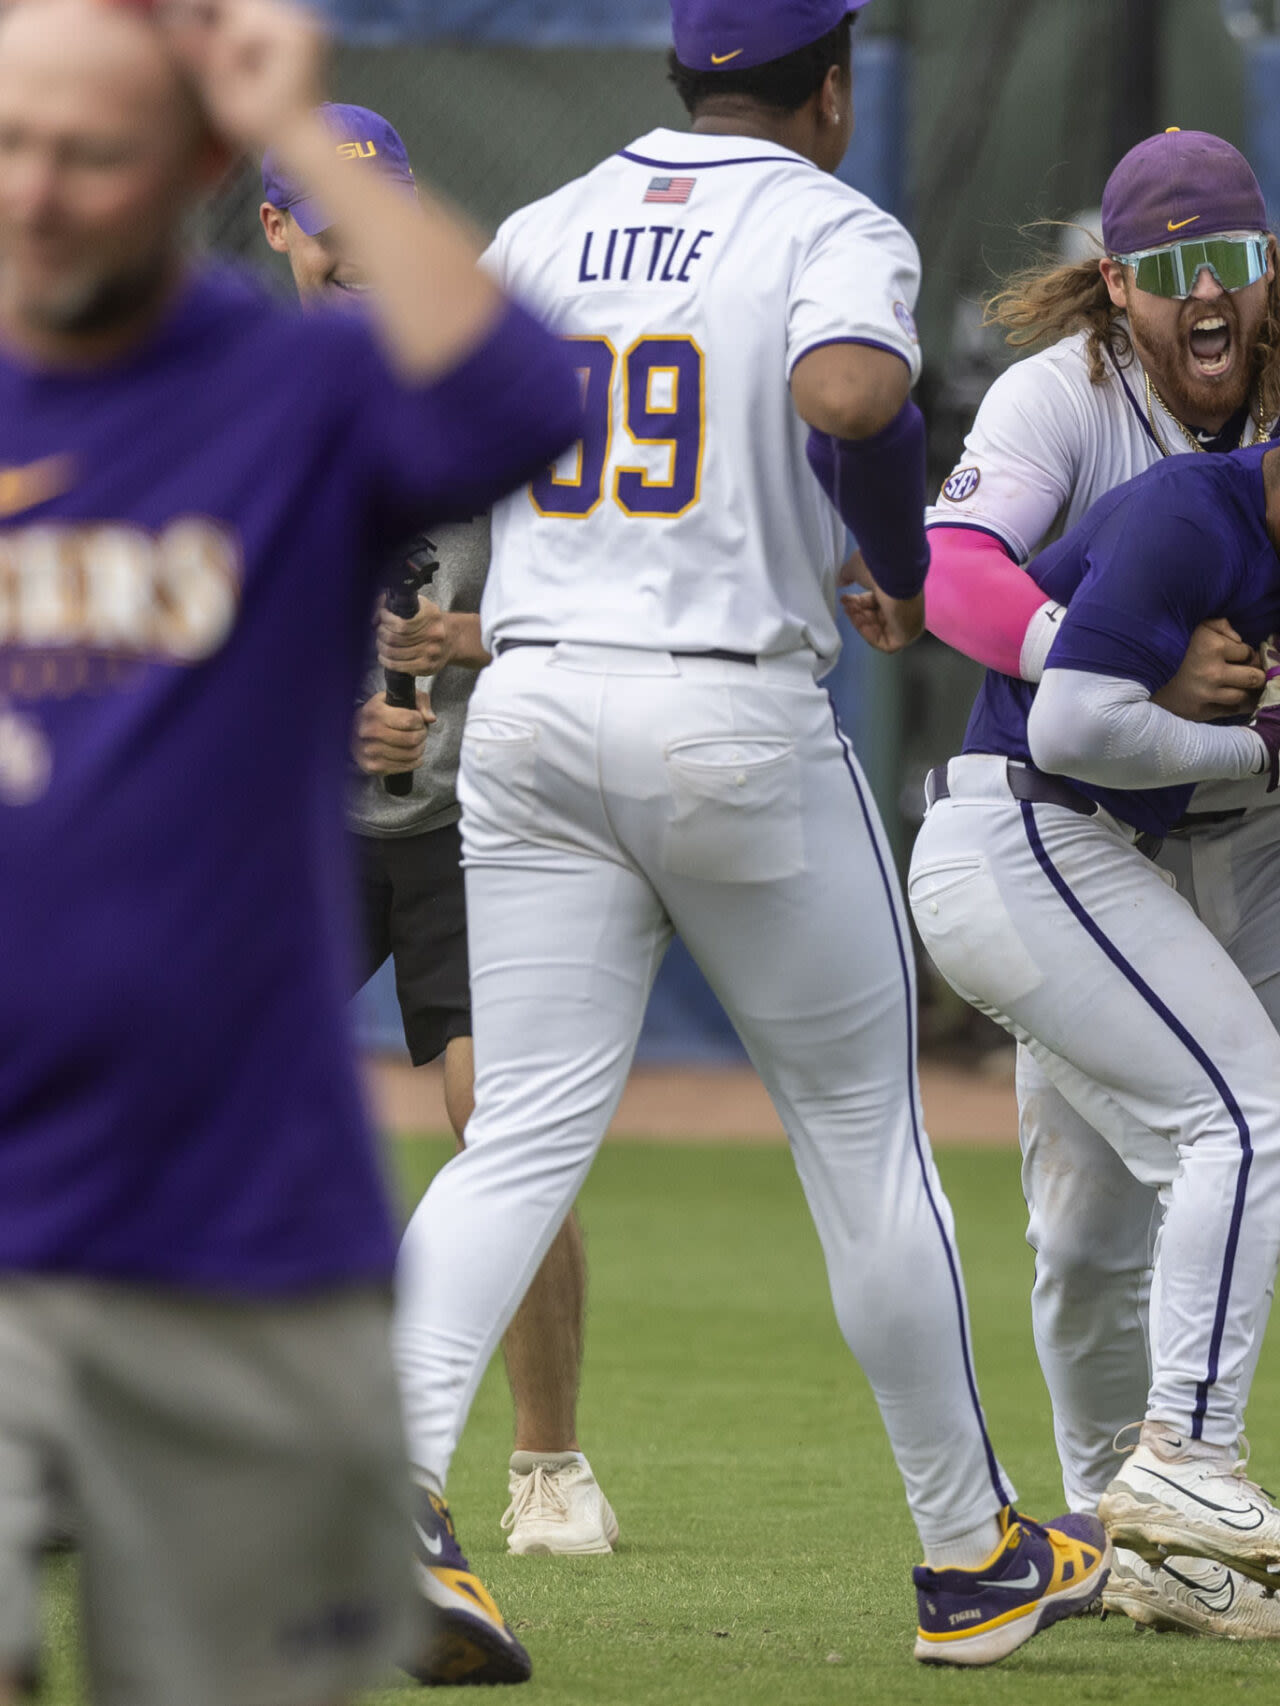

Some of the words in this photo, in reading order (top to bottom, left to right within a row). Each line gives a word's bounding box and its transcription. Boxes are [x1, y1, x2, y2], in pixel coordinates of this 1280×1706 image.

[335, 140, 377, 160] SU
[578, 225, 714, 282] LITTLE
[944, 468, 979, 500] SEC
[948, 1608, 982, 1626] TIGERS
